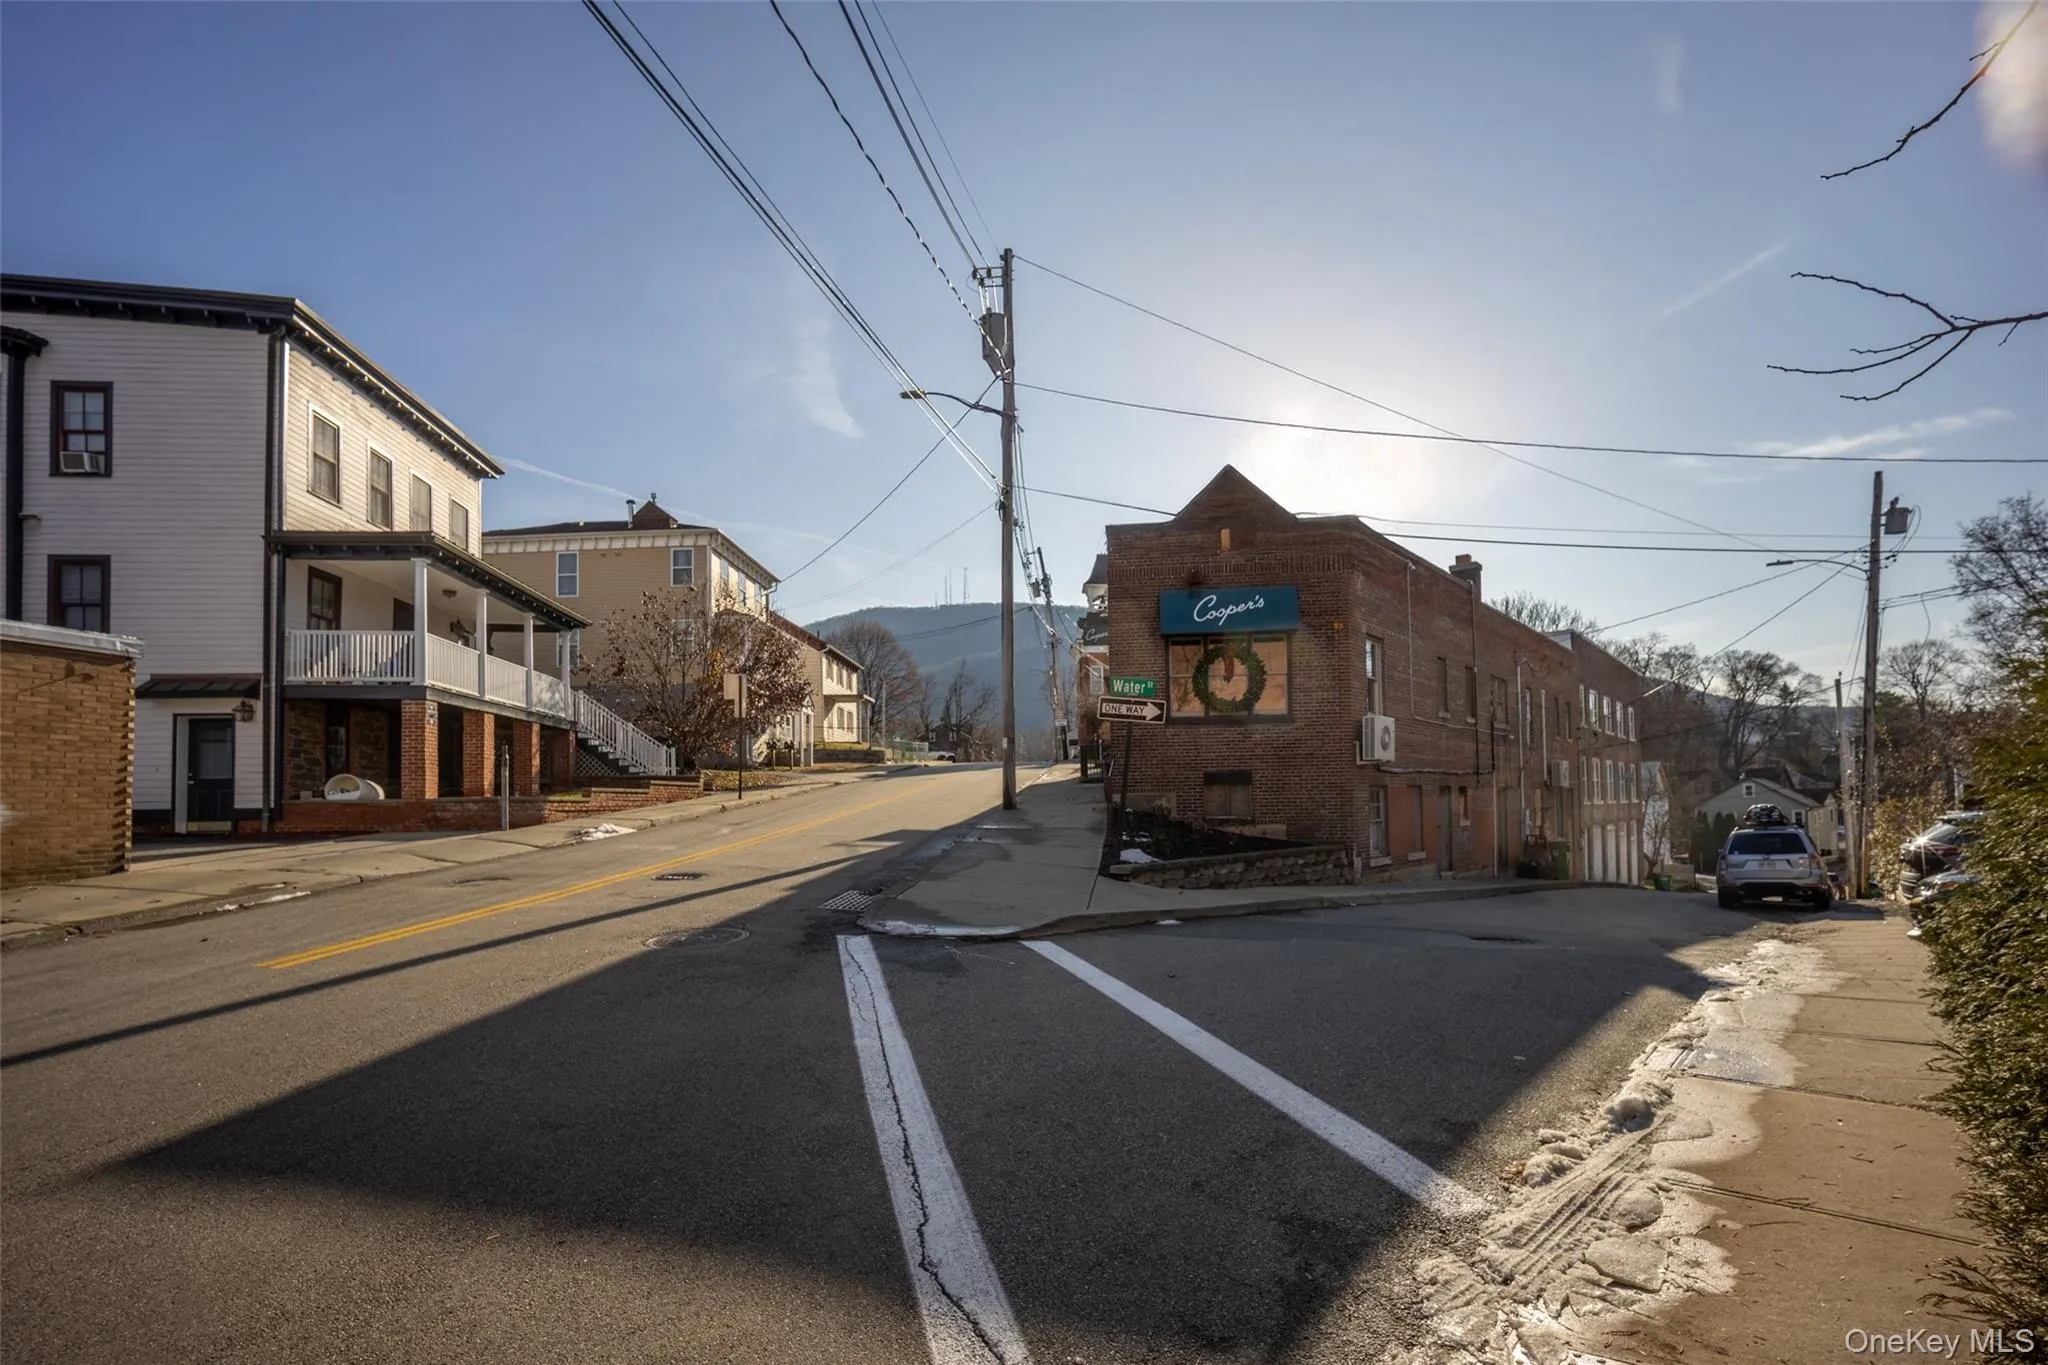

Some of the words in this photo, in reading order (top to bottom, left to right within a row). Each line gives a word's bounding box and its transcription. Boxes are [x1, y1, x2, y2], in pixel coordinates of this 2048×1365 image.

[1194, 594, 1265, 626] Cooper's
[1113, 679, 1145, 693] Water
[1104, 704, 1122, 713] ONE
[1126, 706, 1145, 715] WAY
